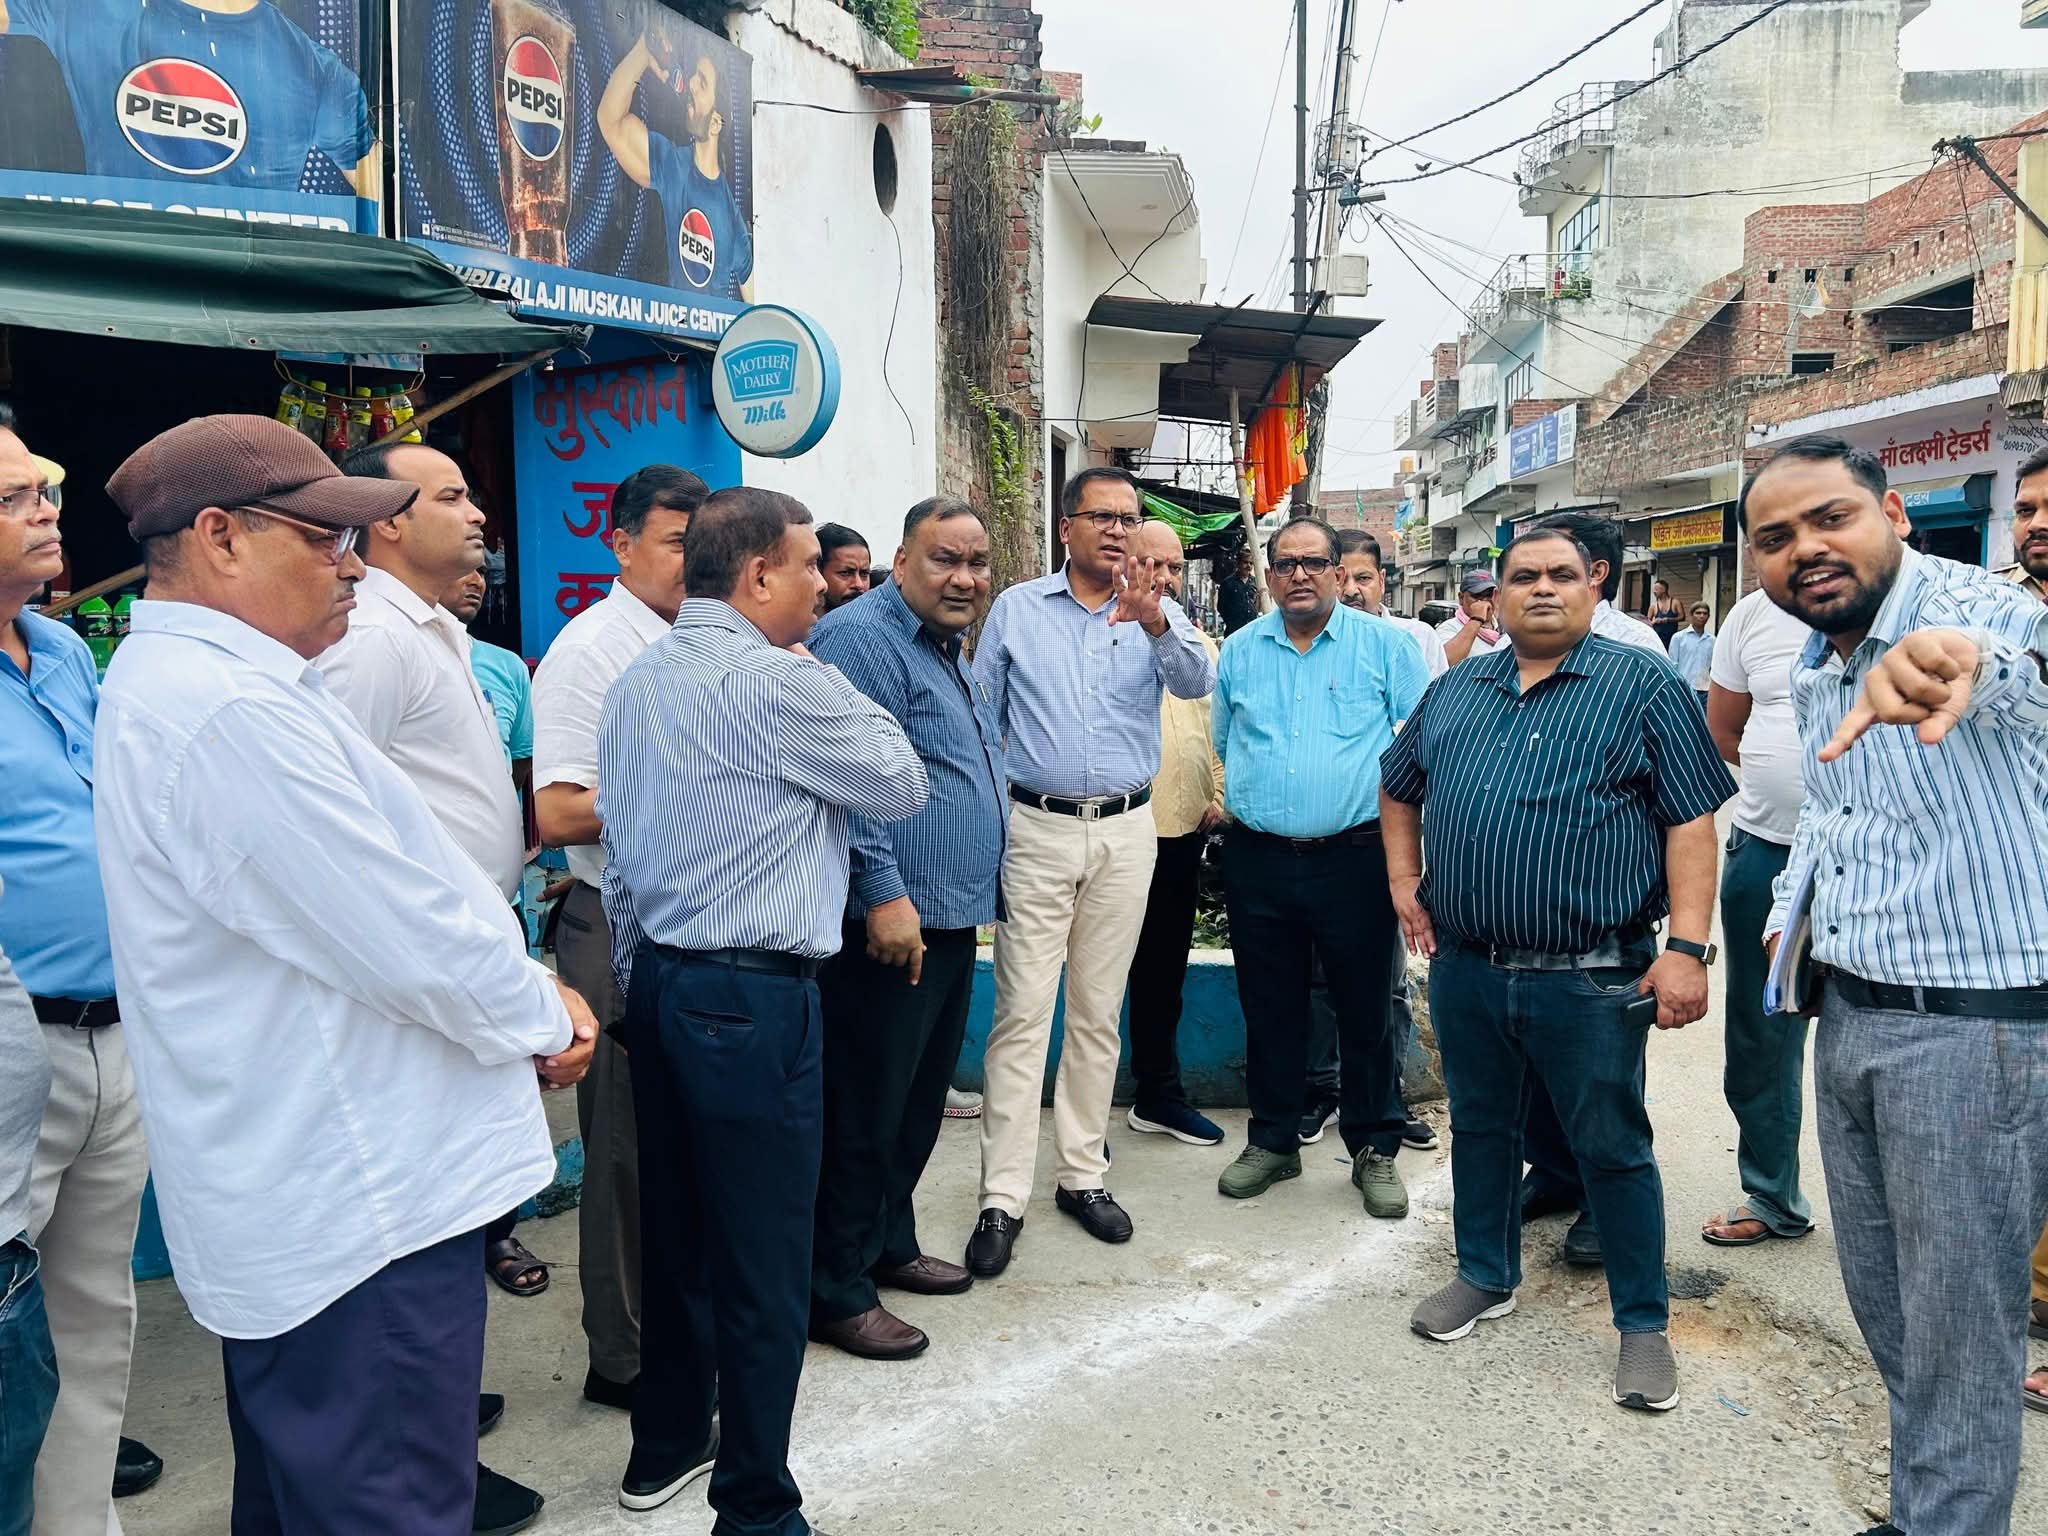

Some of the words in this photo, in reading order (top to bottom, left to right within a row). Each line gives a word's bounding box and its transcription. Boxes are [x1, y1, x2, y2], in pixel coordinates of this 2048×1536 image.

[126, 93, 239, 140] PEPSI
[507, 77, 562, 121] PEPSI
[681, 234, 713, 264] PEPSI
[495, 272, 566, 310] BALAJI
[568, 286, 642, 322] MUSKAN
[644, 300, 689, 329] JUICE
[689, 307, 737, 334] CENTE
[731, 354, 790, 379] MOTHER
[743, 372, 782, 390] DAIRY
[534, 360, 687, 461] मुस्कान
[742, 400, 786, 425] Milk
